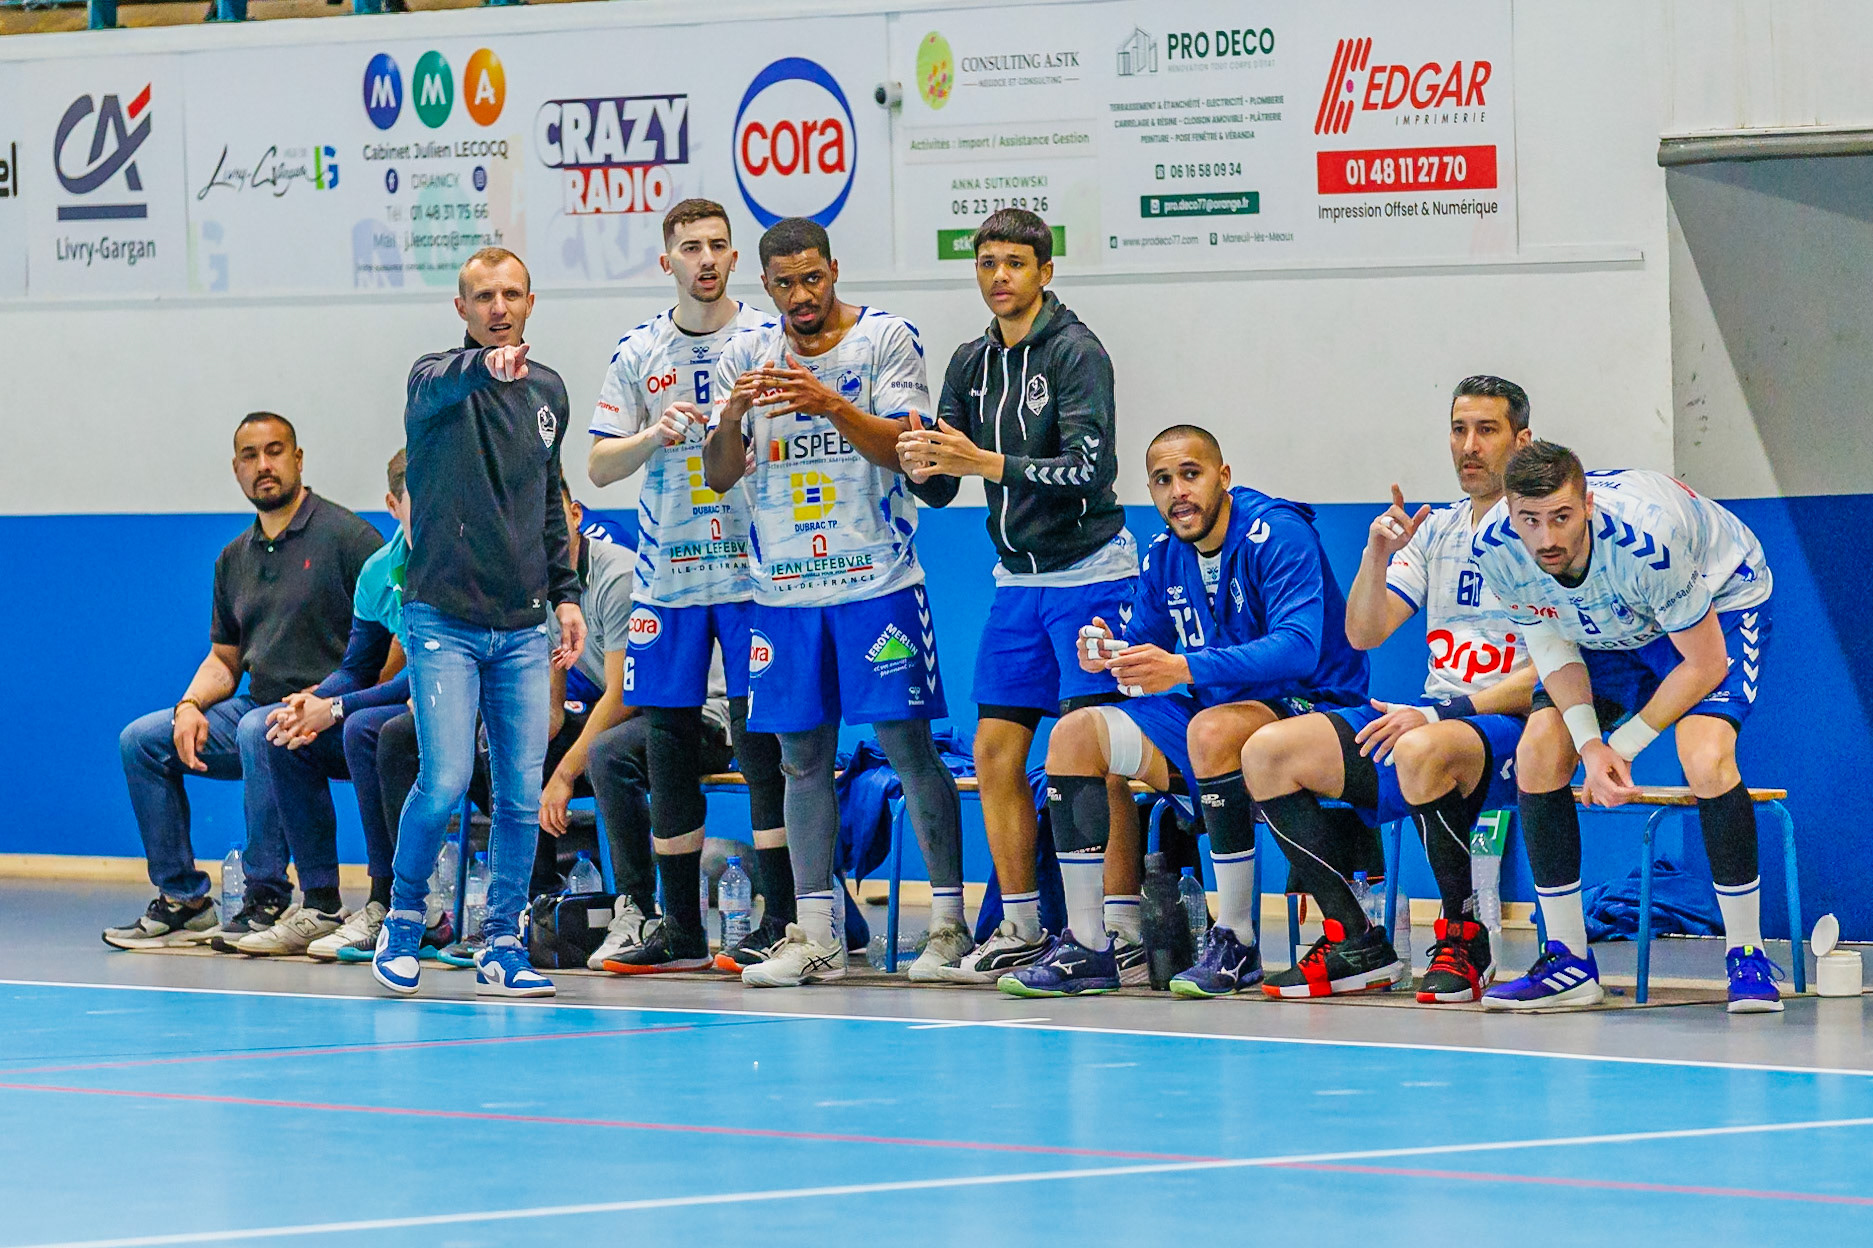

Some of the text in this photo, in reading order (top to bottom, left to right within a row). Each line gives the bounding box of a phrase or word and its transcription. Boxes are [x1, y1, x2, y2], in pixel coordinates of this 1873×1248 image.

[1167, 27, 1275, 60] PRO DECO
[961, 54, 1041, 73] CONSULTING
[1362, 60, 1492, 111] EDGAR
[1395, 111, 1486, 126] IMPRIMERIE
[534, 97, 688, 168] CRAZY
[1000, 133, 1049, 147] Assistance
[1053, 131, 1089, 145] Gestion
[362, 142, 411, 161] Cabinet
[454, 140, 509, 159] LECOCQ
[741, 118, 846, 177] cora
[1170, 162, 1242, 178] 06 16 58 09 34
[1346, 155, 1467, 185] 01 48 11 27 70
[564, 165, 673, 215] RADIO
[952, 175, 1048, 190] ANNA SUTKOWSKI
[952, 200, 969, 215] 06
[973, 199, 988, 214] 23
[1033, 197, 1049, 212] 26
[1318, 198, 1498, 223] Impression Offset & Numérique
[56, 237, 156, 266] Livry-Gargan
[693, 504, 731, 516] DUBRAC TP
[795, 519, 838, 532] DUBRAC TP
[670, 544, 702, 558] JEAN
[706, 541, 748, 555] LEFEBV
[771, 554, 873, 576] JEAN LEFEBVRE
[628, 617, 658, 635] cora
[864, 622, 919, 663] LEROY MERLIN
